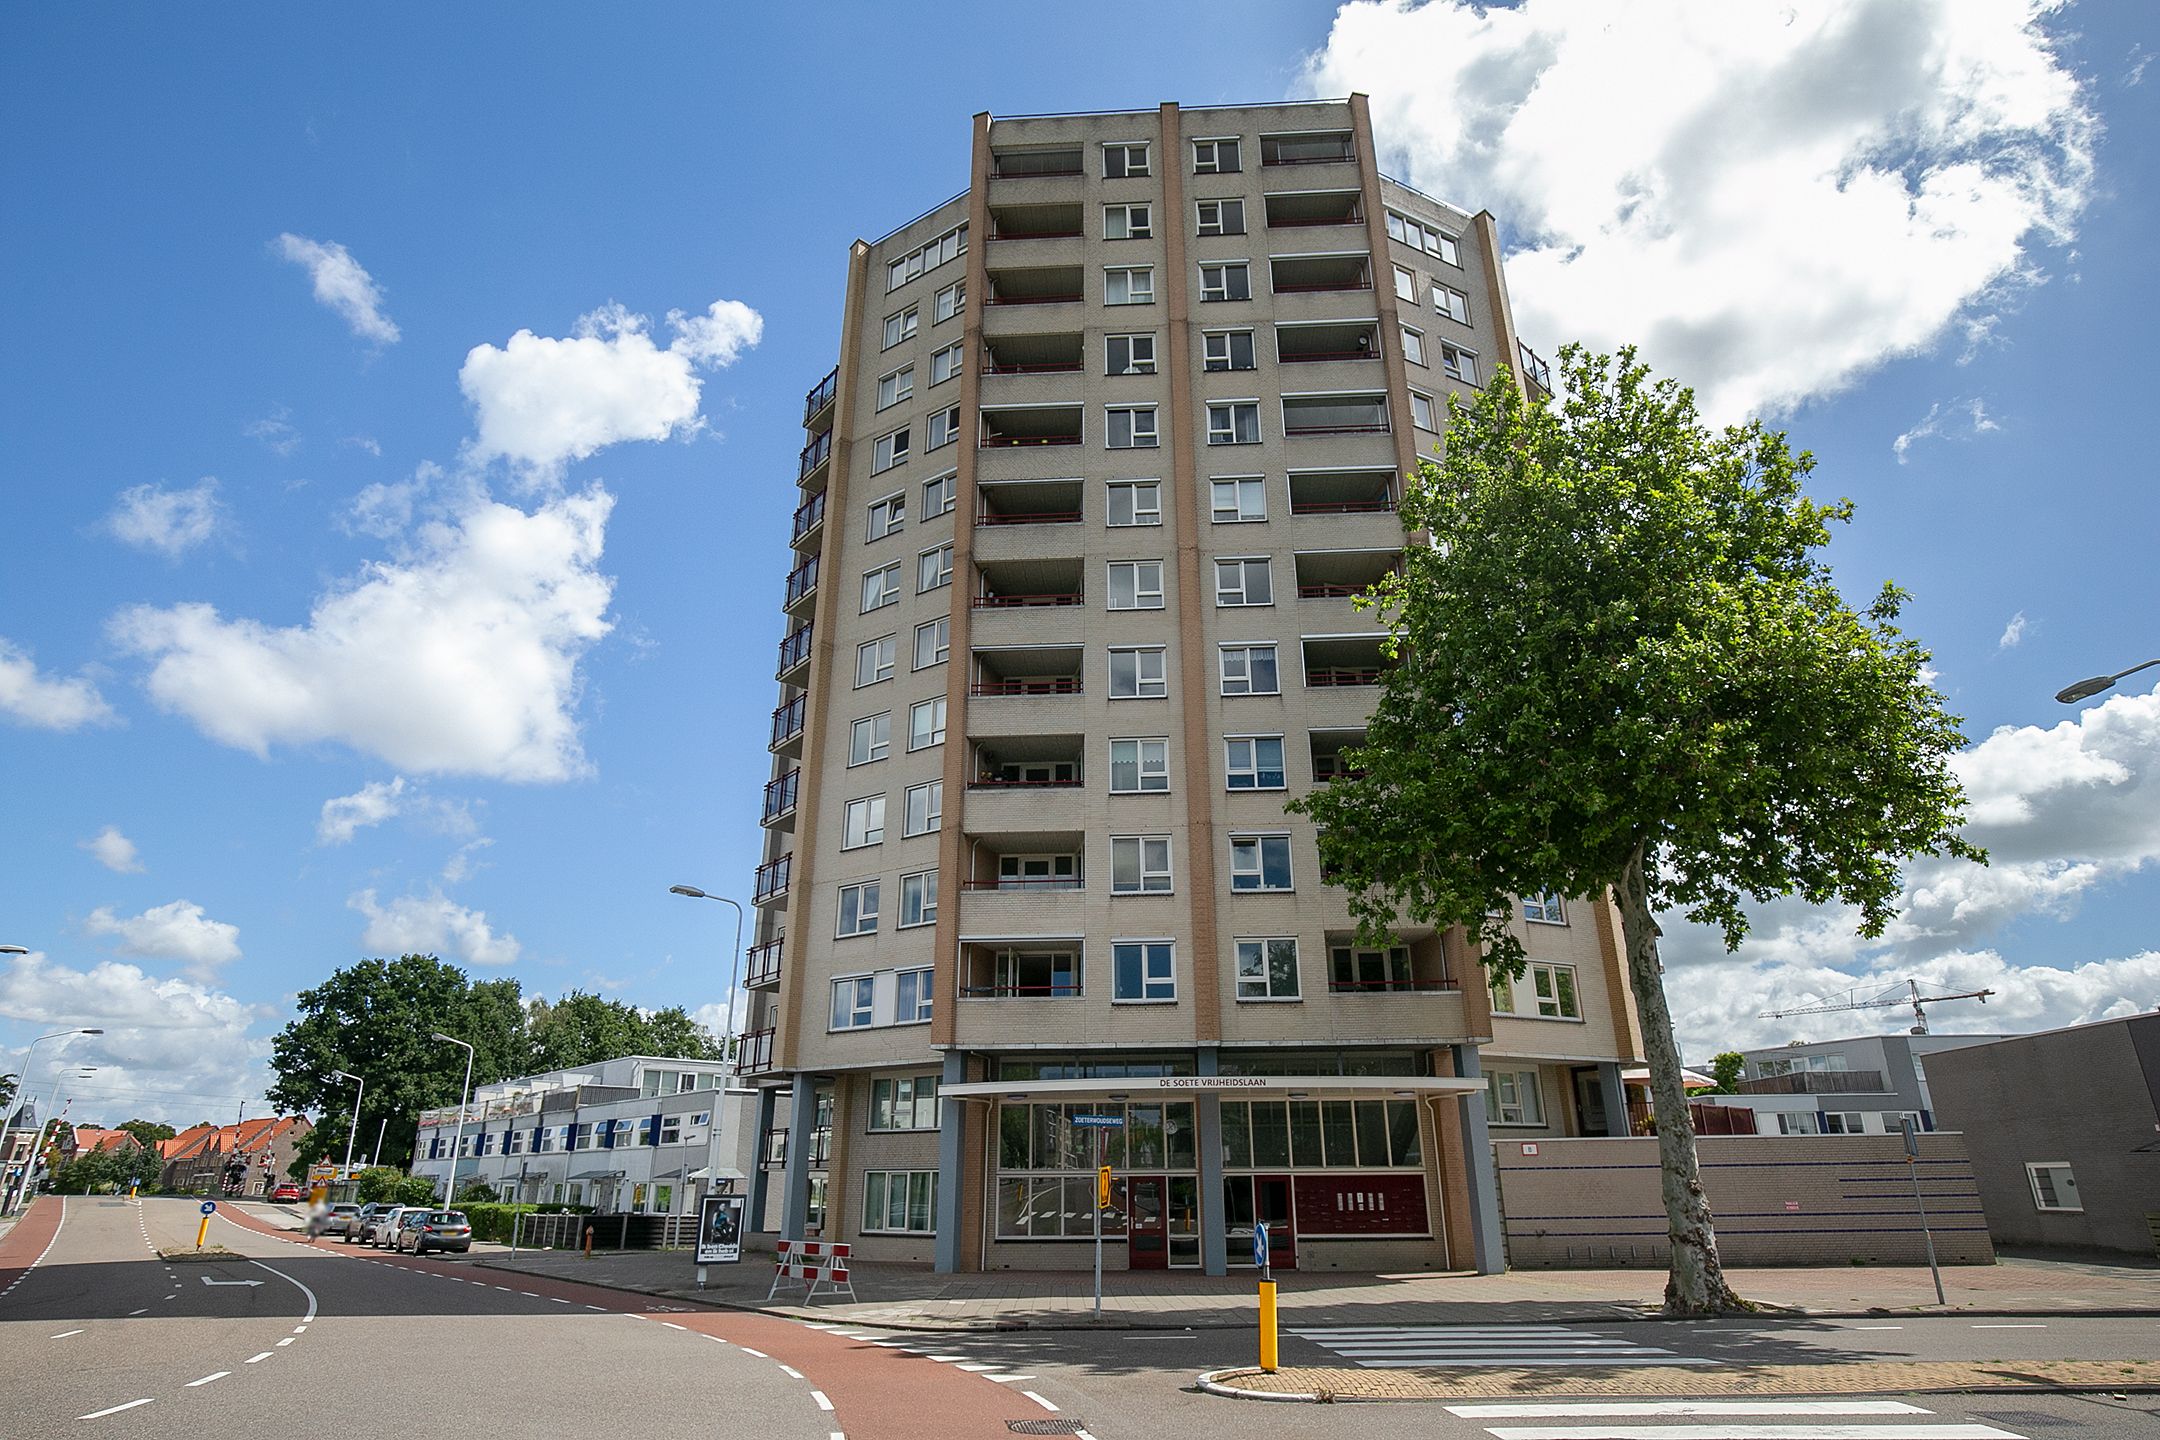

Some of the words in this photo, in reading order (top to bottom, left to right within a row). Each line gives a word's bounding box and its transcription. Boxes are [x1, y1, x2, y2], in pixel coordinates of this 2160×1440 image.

[1160, 1079, 1170, 1087] DE
[1173, 1079, 1199, 1087] SOETE
[1201, 1078, 1266, 1087] VRIJHEIDSLAAN
[1074, 1116, 1123, 1124] ZOETERWOUDSEWEG
